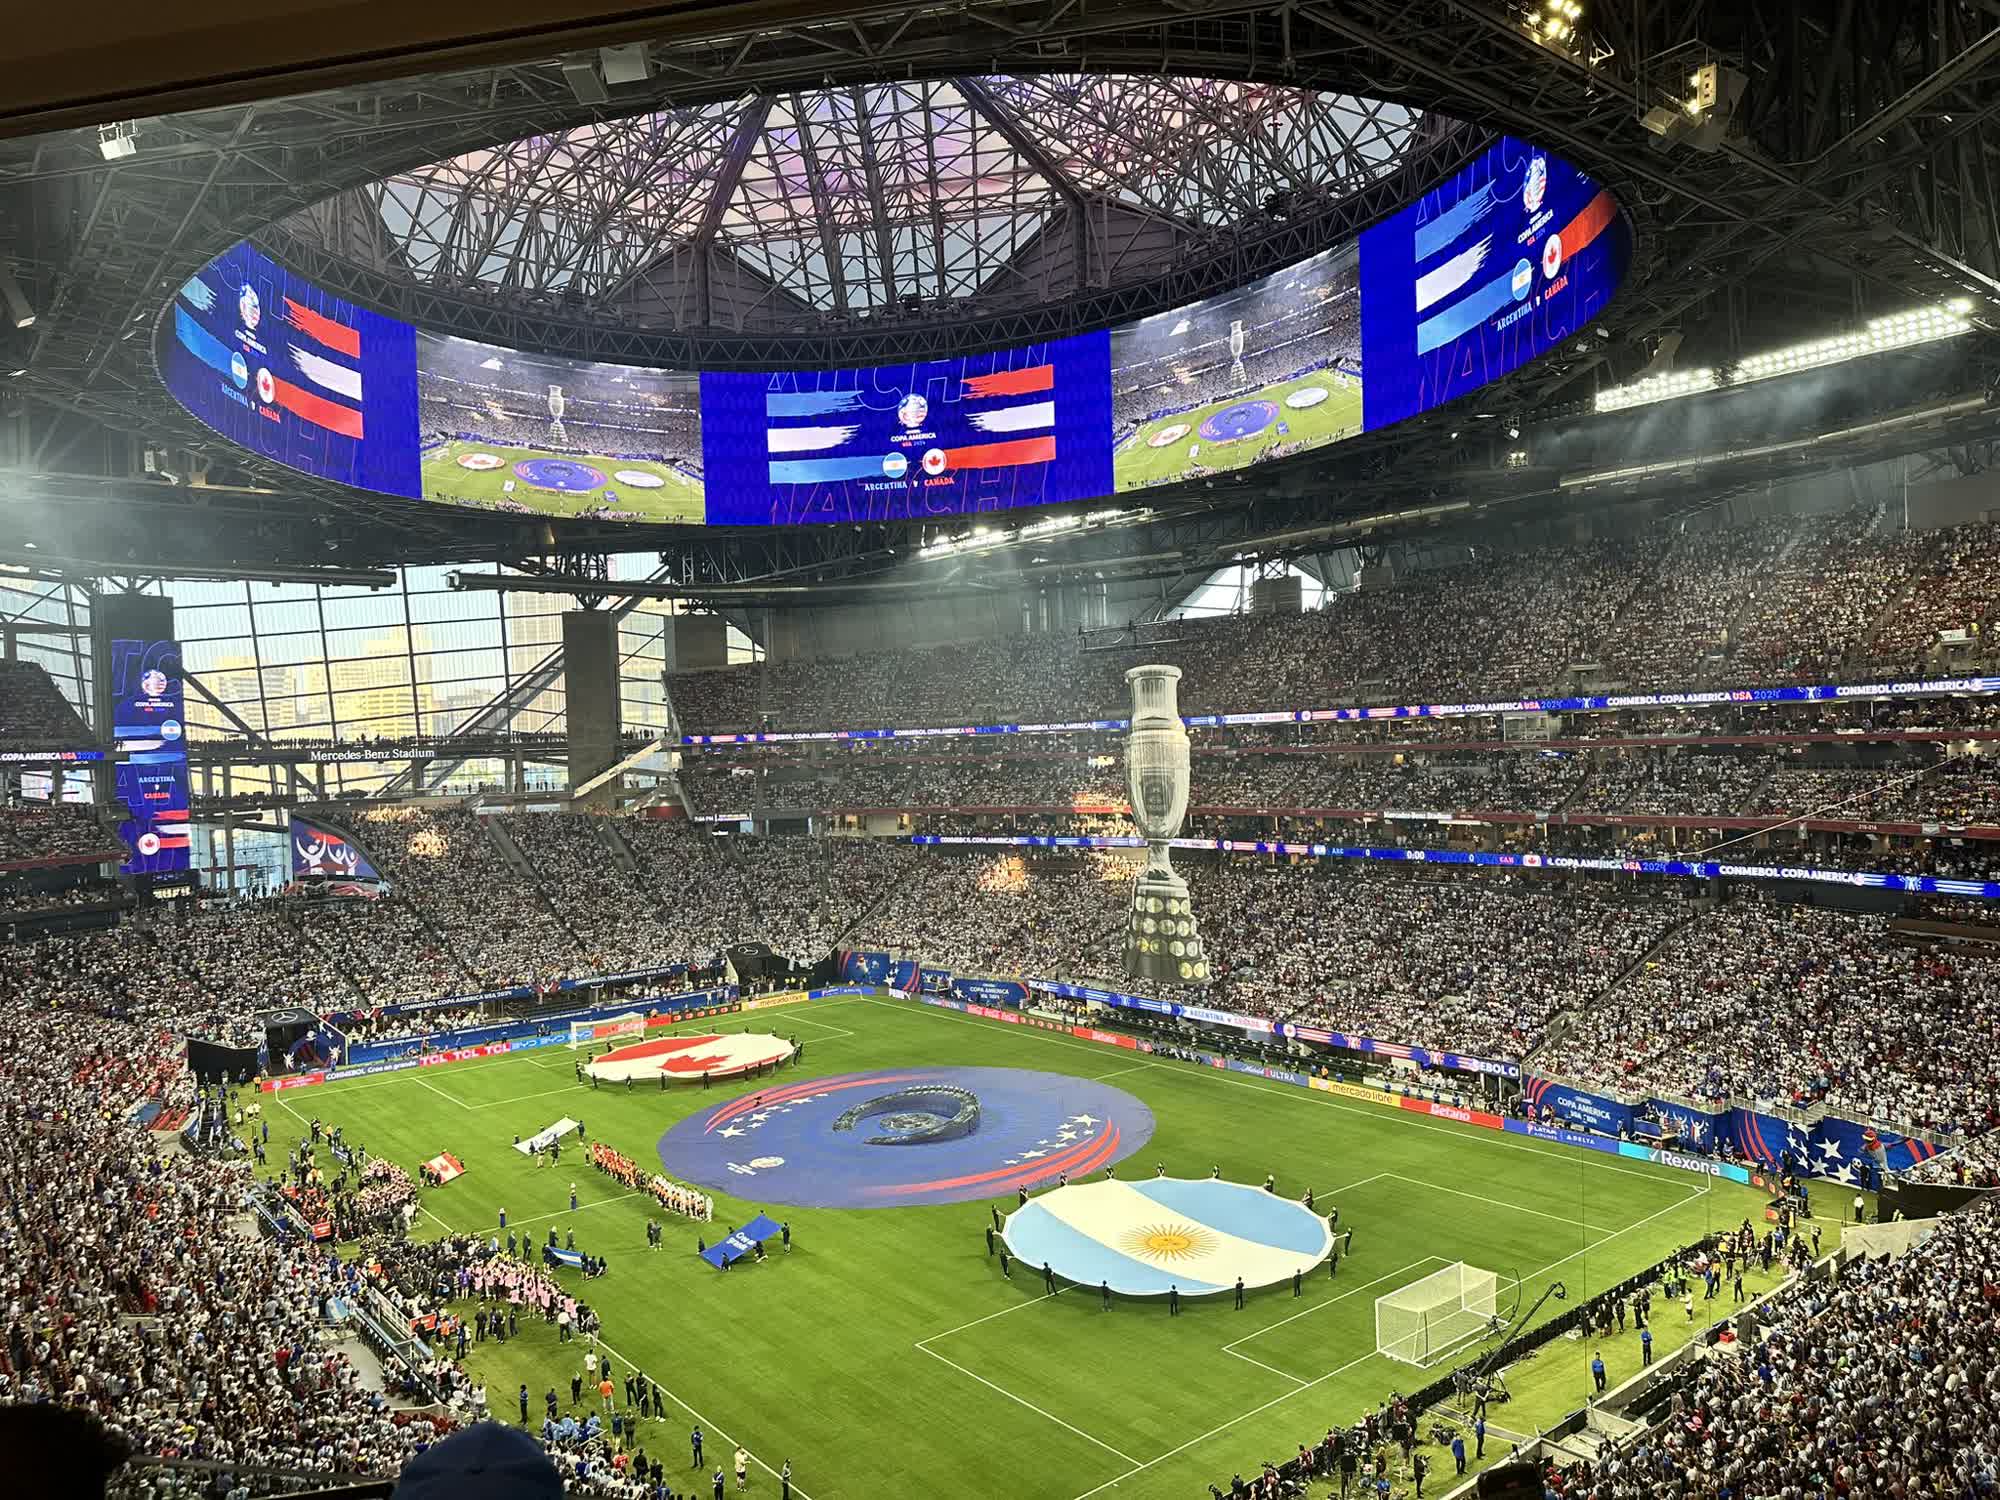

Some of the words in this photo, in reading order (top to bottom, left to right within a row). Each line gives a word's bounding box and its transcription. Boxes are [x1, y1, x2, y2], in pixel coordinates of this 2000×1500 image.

[1544, 275, 1569, 300] CANADA
[908, 432, 937, 441] AMERICA
[864, 480, 908, 492] ARGENTINA
[924, 476, 956, 487] CANADA
[1836, 684, 1892, 696] CONMEBOL
[1892, 683, 1921, 694] COPA
[1921, 680, 1970, 692] AMERICA
[1606, 695, 1659, 706] CONMEBOL
[1659, 694, 1686, 704] COPA
[1686, 692, 1732, 703] AMERICA
[1732, 691, 1753, 701] USA
[1466, 703, 1487, 712] COPA
[1487, 701, 1524, 711] AMERICA
[1524, 700, 1541, 710] USA
[1, 752, 25, 761] COPA
[25, 752, 61, 760] AMERICA
[61, 752, 77, 760] USA
[310, 749, 391, 762] Mercedes-Benz
[392, 747, 435, 759] Stadium
[1554, 858, 1579, 868] COPA
[1579, 859, 1623, 870] AMERICA
[1623, 861, 1642, 871] USA
[1719, 865, 1781, 878] CONMEBOL
[1781, 868, 1809, 880] COPA
[1809, 870, 1856, 883] AMERICA
[985, 987, 1009, 995] AMERICA
[399, 1000, 437, 1012] CONMEBOL
[437, 997, 456, 1006] COPA
[455, 994, 484, 1004] AMERICA
[511, 1040, 537, 1050] BYD
[540, 1036, 565, 1045] BYD
[453, 1049, 480, 1061] TCL
[484, 1042, 512, 1055] TCL
[421, 1054, 449, 1067] TCL
[325, 1069, 366, 1081] CONMEBOL
[1270, 1071, 1296, 1082] ULTRA
[1332, 1081, 1373, 1100] mercado
[1372, 1090, 1393, 1104] libre
[1430, 1101, 1471, 1122] Betano
[1557, 1096, 1577, 1109] COPA
[1577, 1101, 1611, 1120] AMERICA
[1573, 1135, 1595, 1145] DELTA
[1661, 1150, 1721, 1177] Rexona
